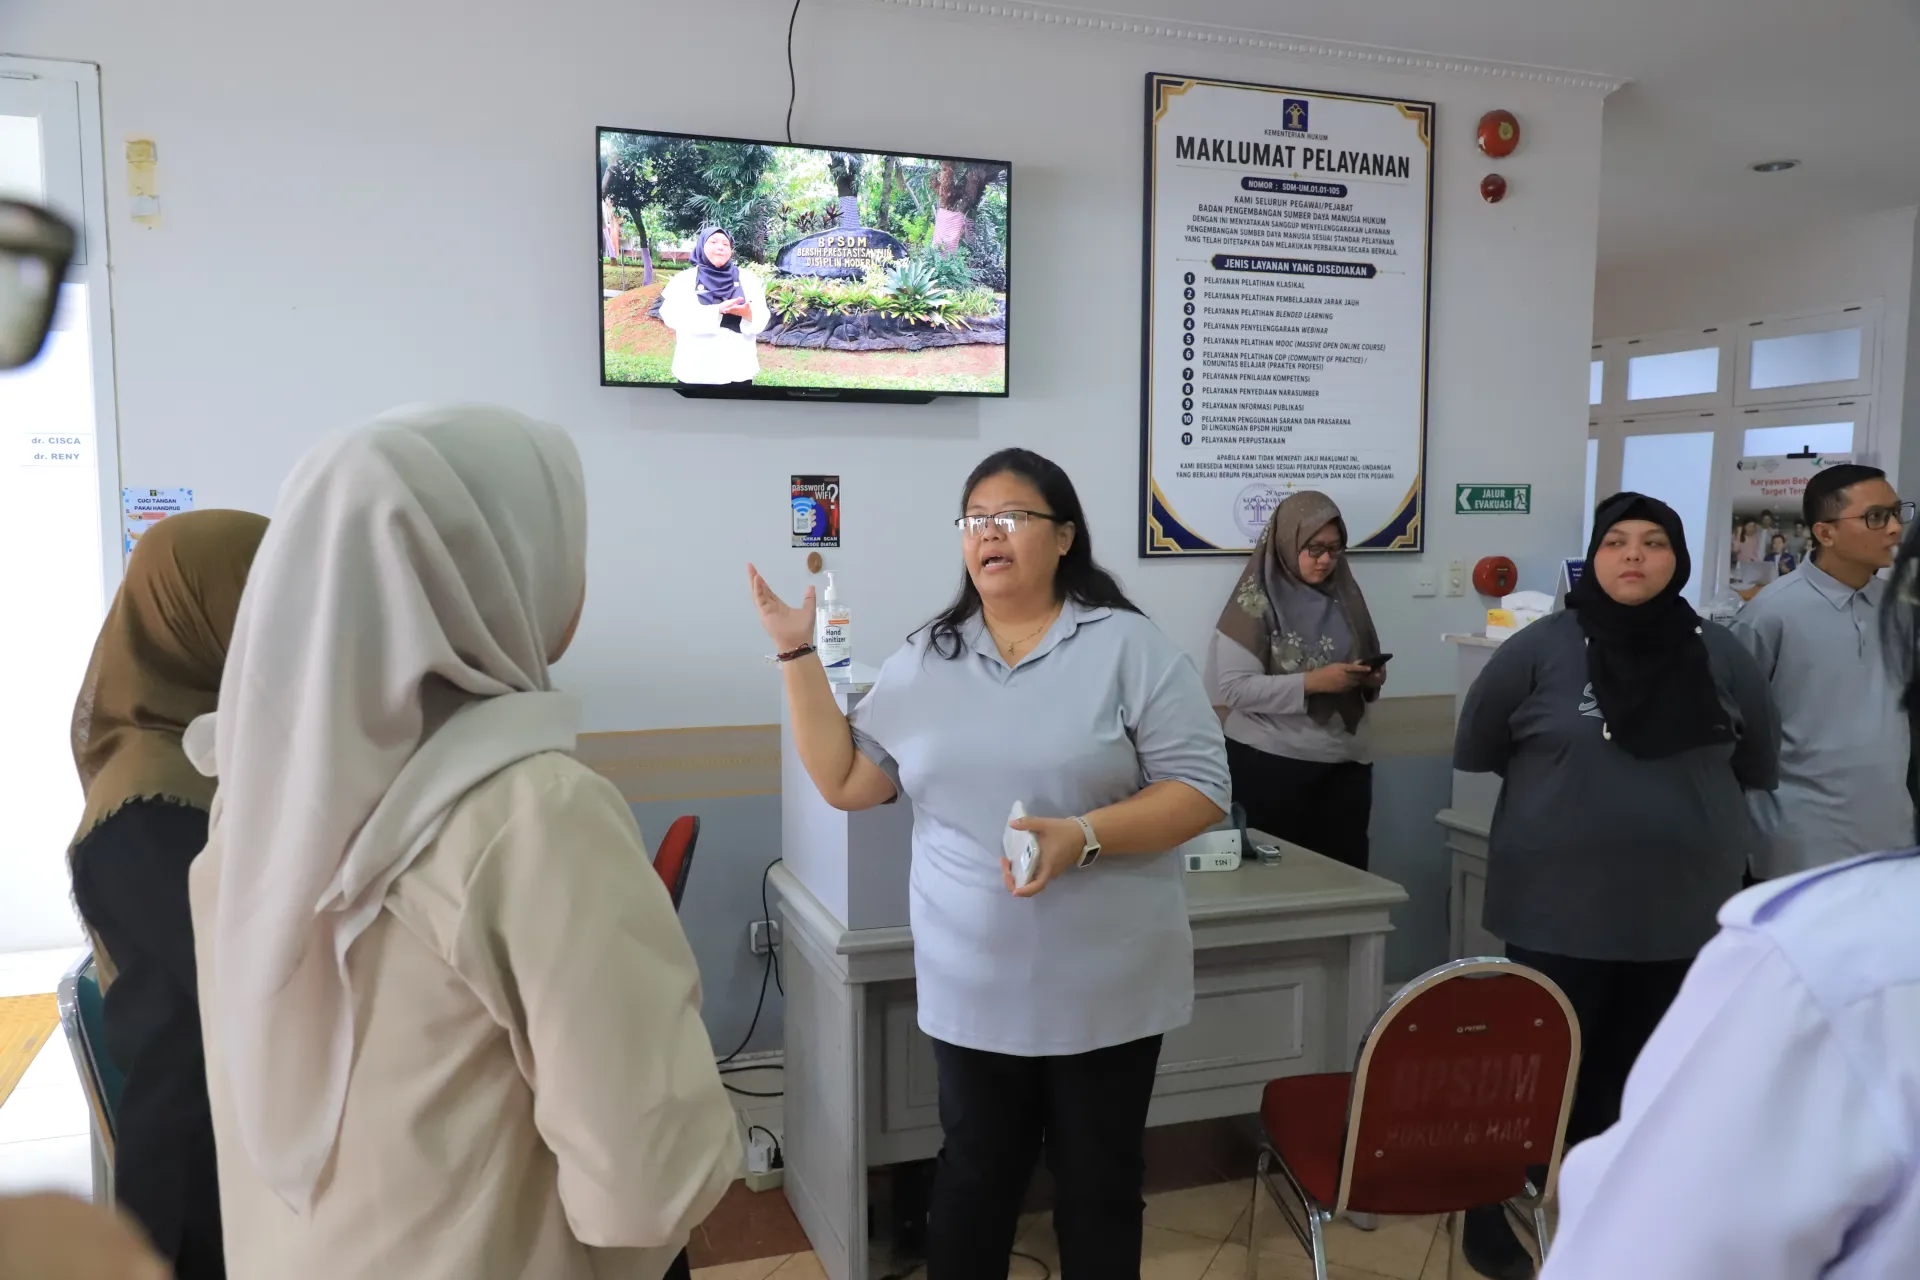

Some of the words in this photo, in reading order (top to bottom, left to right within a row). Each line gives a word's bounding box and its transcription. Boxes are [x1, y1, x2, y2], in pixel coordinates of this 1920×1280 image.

[1264, 129, 1305, 138] KEMENTERIAN
[1176, 136, 1296, 168] MAKLUMAT
[1303, 148, 1409, 178] PELAYANAN
[1248, 180, 1272, 189] NOMOR
[1282, 183, 1340, 194] SDM-UM.01.01-105
[1234, 196, 1252, 204] KAMI
[1256, 197, 1287, 206] SELURUH
[1290, 200, 1353, 211] PEGAWAI/PEJABAT
[1199, 204, 1222, 213] BADAN
[1225, 206, 1282, 217] PENGEMBANGAN
[1284, 211, 1311, 220] SUMBER
[1331, 214, 1360, 223] MANUSIA
[1363, 217, 1386, 225] HUKUM
[1192, 215, 1218, 223] DENGAN
[1230, 218, 1270, 227] MENYATAKAN
[1301, 223, 1363, 233] MENYELENGGARAKAN
[1187, 225, 1238, 235] PENGEMBANGAN
[1240, 229, 1264, 237] SUMBER
[1362, 237, 1394, 245] PELAYANAN
[818, 236, 867, 248] BPSDM
[1223, 238, 1259, 247] DITETAPKAN
[1276, 241, 1312, 250] MELAKUKAN
[797, 248, 822, 257] BERSIH
[824, 248, 860, 257] PRESTASI
[807, 258, 841, 267] DISIPLIN
[1224, 259, 1249, 269] JENIS
[1252, 260, 1289, 271] LAYANAN
[1292, 263, 1314, 272] YANG
[1317, 264, 1367, 276] DISEDIAKAN
[1204, 277, 1239, 285] PELAYANAN
[1242, 279, 1274, 287] PELATIHAN
[1204, 292, 1239, 300] PELAYANAN
[1276, 296, 1322, 304] PEMBELAJARAN
[1204, 307, 1239, 315] PELAYANAN
[1241, 324, 1299, 332] PENYELENGGARAAN
[1750, 478, 1790, 486] Karyawan
[792, 483, 825, 493] password
[1482, 489, 1505, 498] JALUR
[1475, 500, 1512, 509] EVAKUASI
